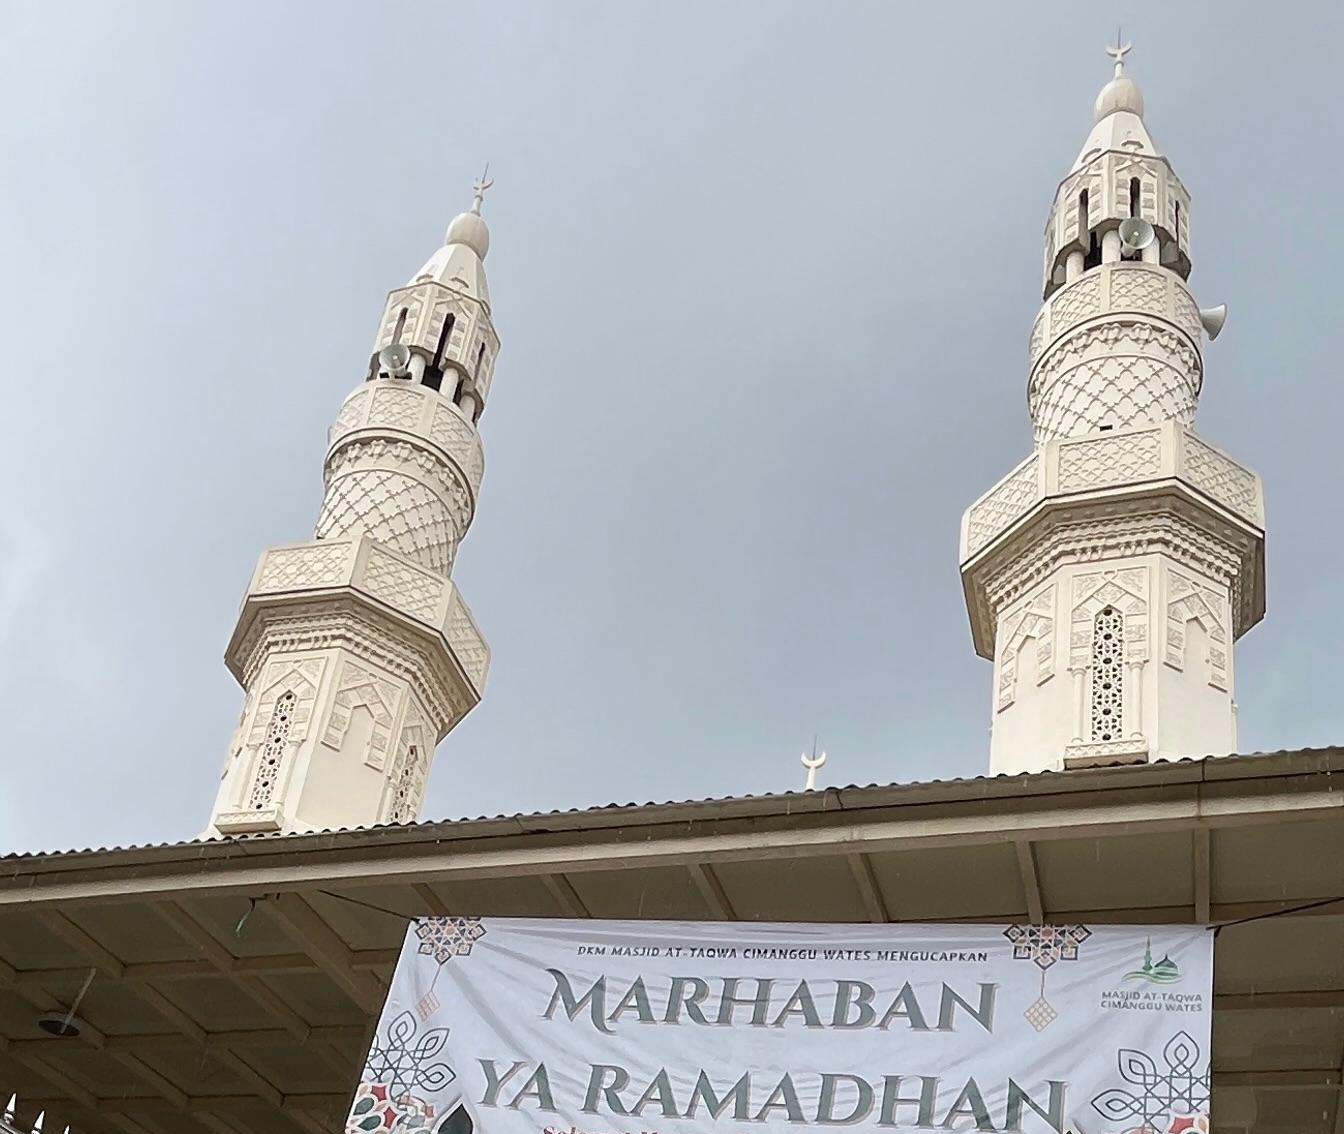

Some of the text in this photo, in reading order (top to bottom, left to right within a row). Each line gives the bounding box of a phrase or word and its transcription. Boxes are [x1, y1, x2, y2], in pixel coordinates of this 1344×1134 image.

[577, 946, 988, 962] DKM MASJID AT-TAQWA CIMANGGU WATES MENGUCAPKAN
[540, 968, 999, 1035] MARHABAN
[1102, 991, 1202, 1002] MASJID AT-TAQWA
[1101, 1001, 1203, 1012] CIMANGGU WATES
[476, 1058, 559, 1113] YA
